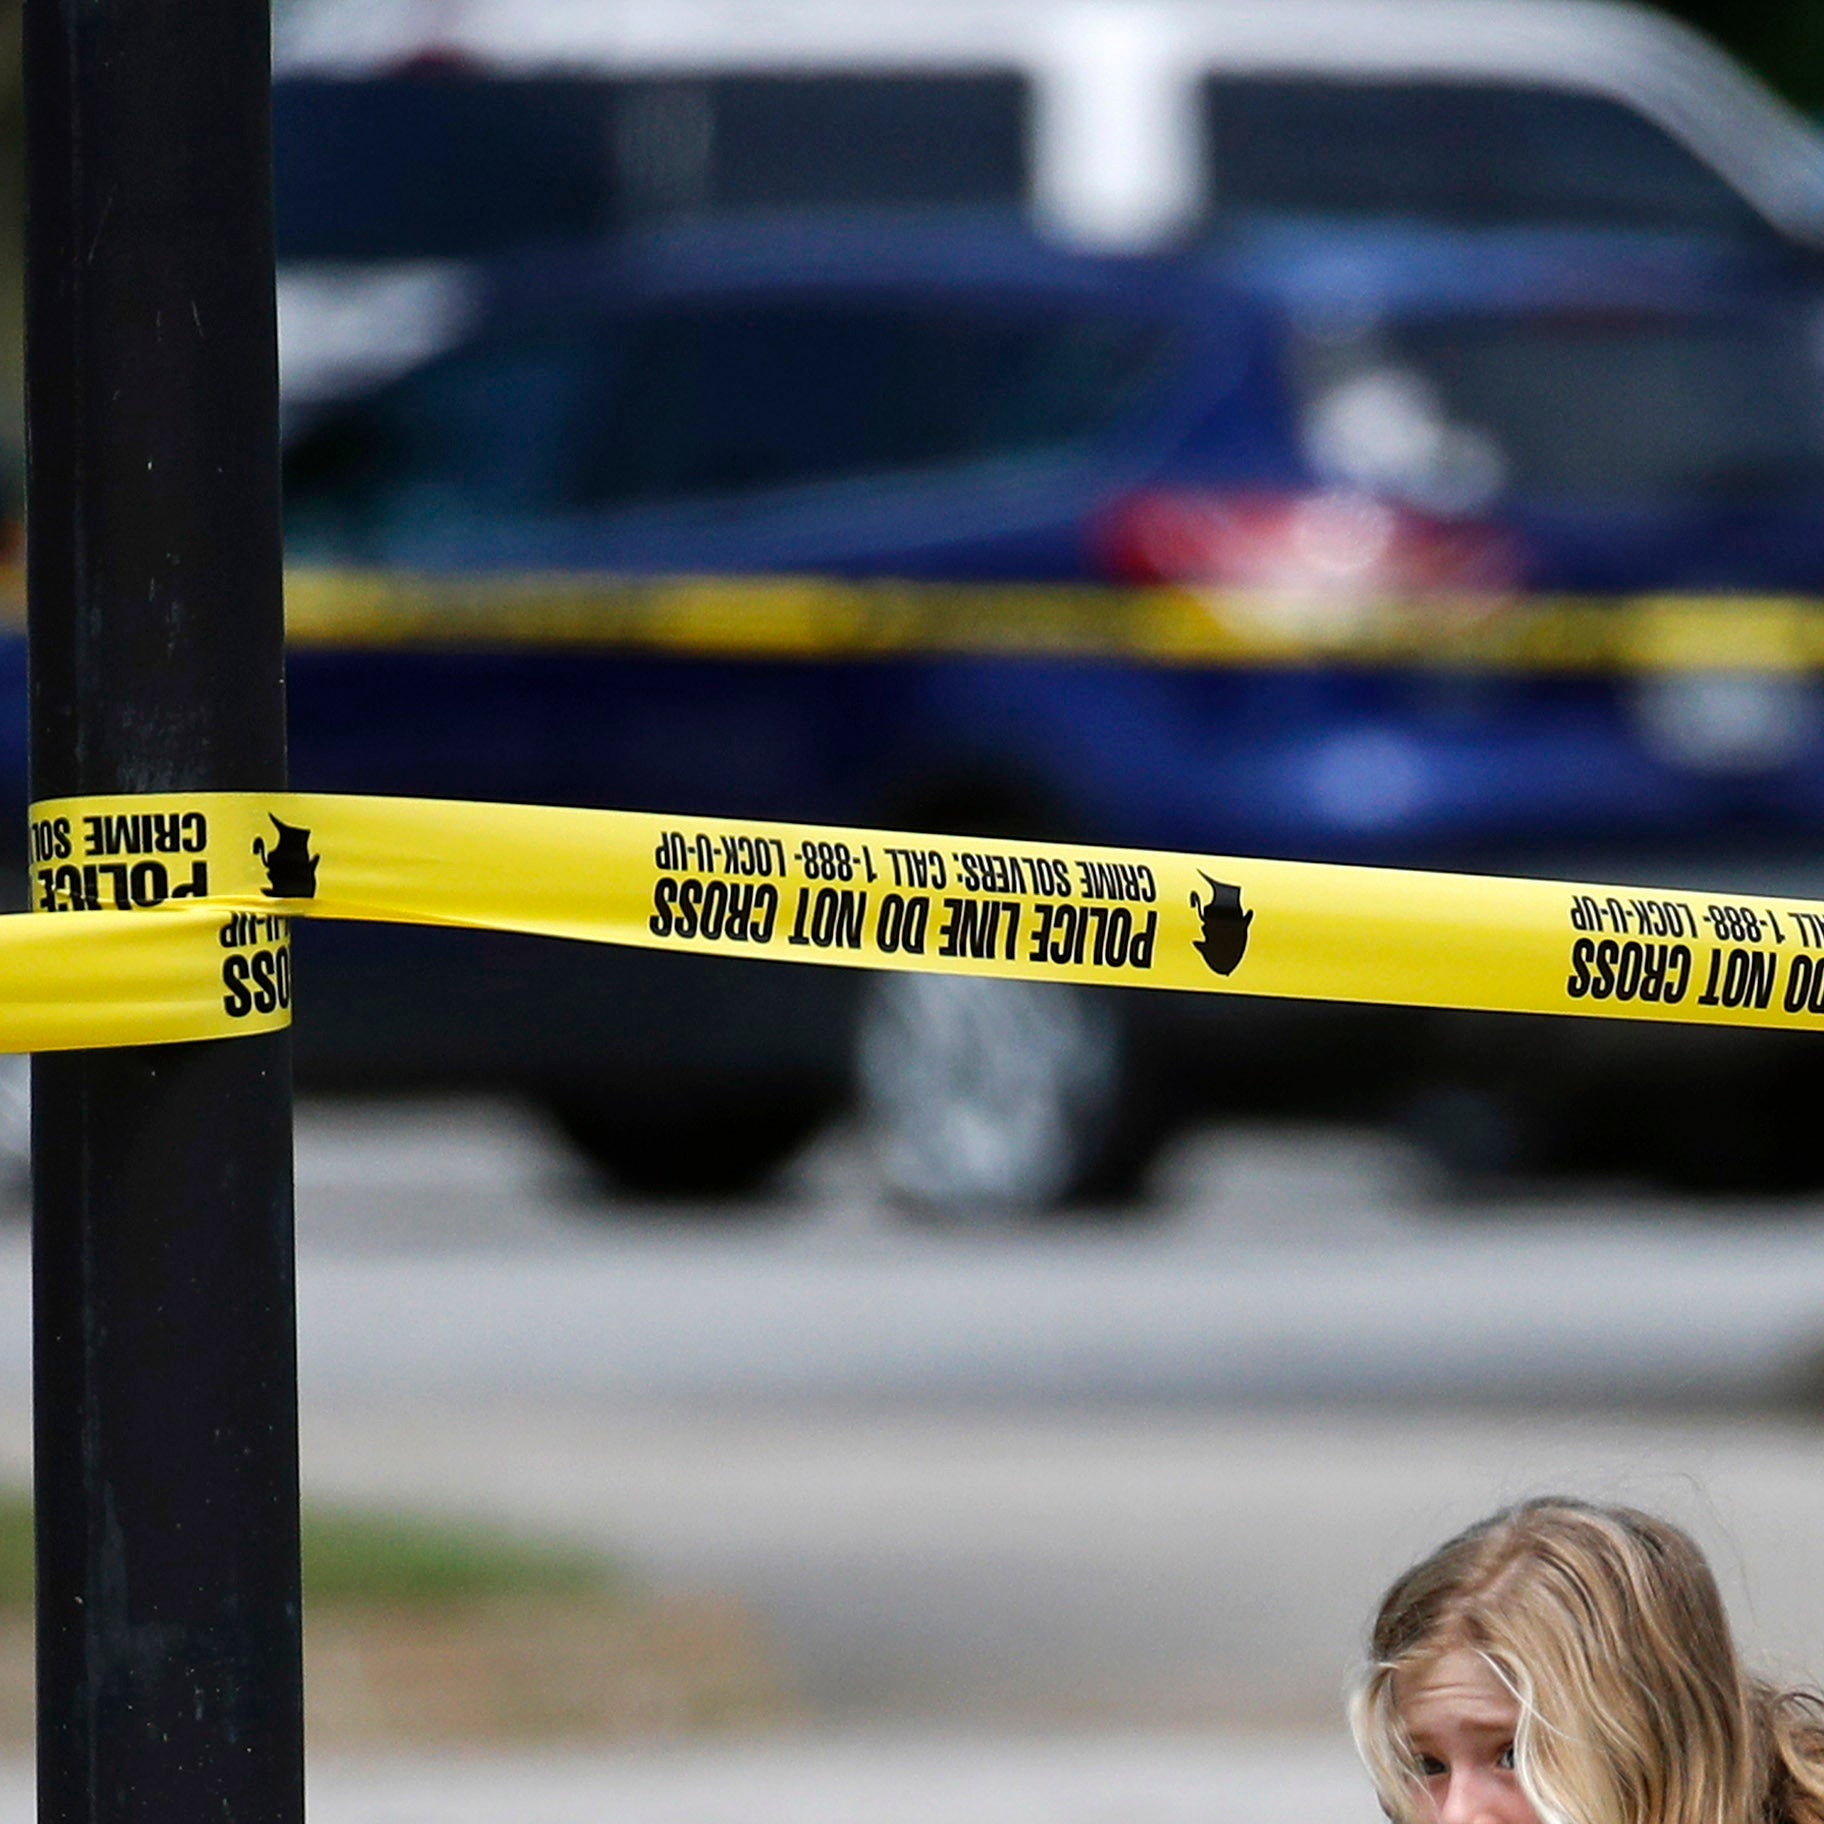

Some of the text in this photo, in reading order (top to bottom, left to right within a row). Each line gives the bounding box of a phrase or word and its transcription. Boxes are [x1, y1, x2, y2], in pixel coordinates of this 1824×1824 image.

[83, 812, 207, 857] CRIME
[884, 848, 947, 890] CALL
[952, 850, 1072, 898] SOLVERS:
[1075, 861, 1157, 903] CRIME
[649, 877, 1158, 969] POLICE LINE DO NOT CROSS
[1567, 937, 1692, 1004] CROSS
[1697, 948, 1777, 1009] NOT
